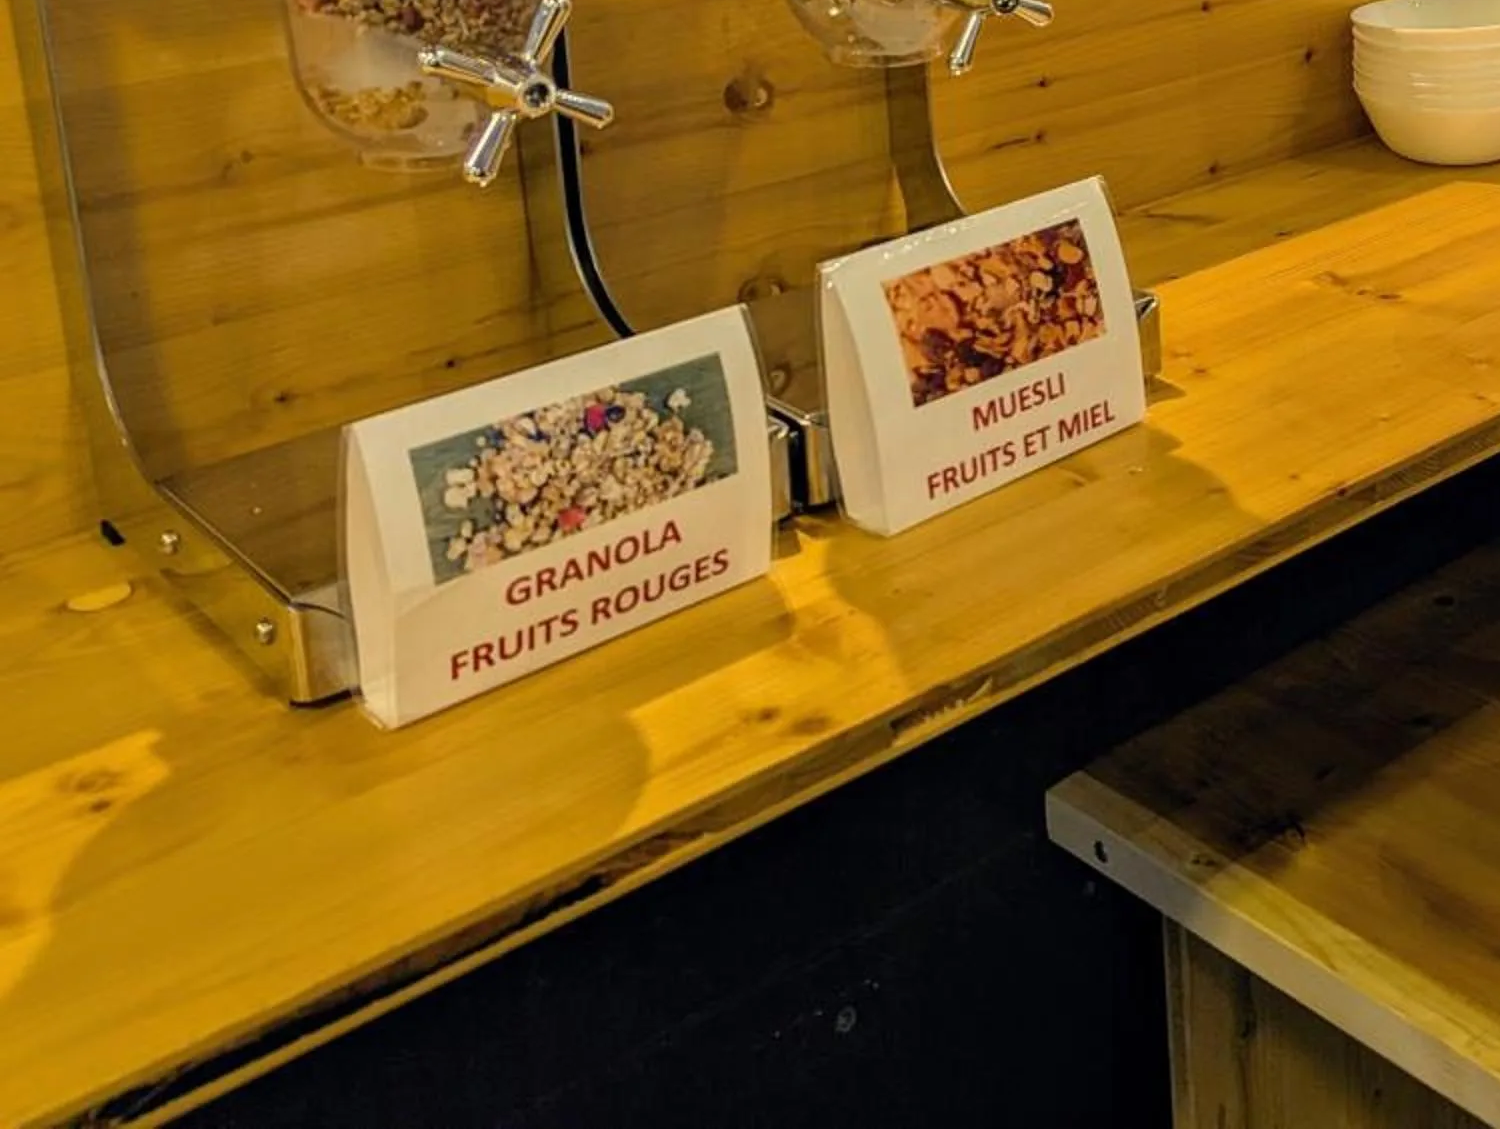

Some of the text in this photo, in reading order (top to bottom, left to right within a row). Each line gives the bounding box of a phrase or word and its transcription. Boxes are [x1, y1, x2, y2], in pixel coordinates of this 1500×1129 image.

[972, 372, 1066, 431] MUESLI
[926, 400, 1116, 500] FRUITS ET MIEL
[504, 520, 683, 607] GRANOLA
[449, 548, 730, 681] FRUITS ROUGES
